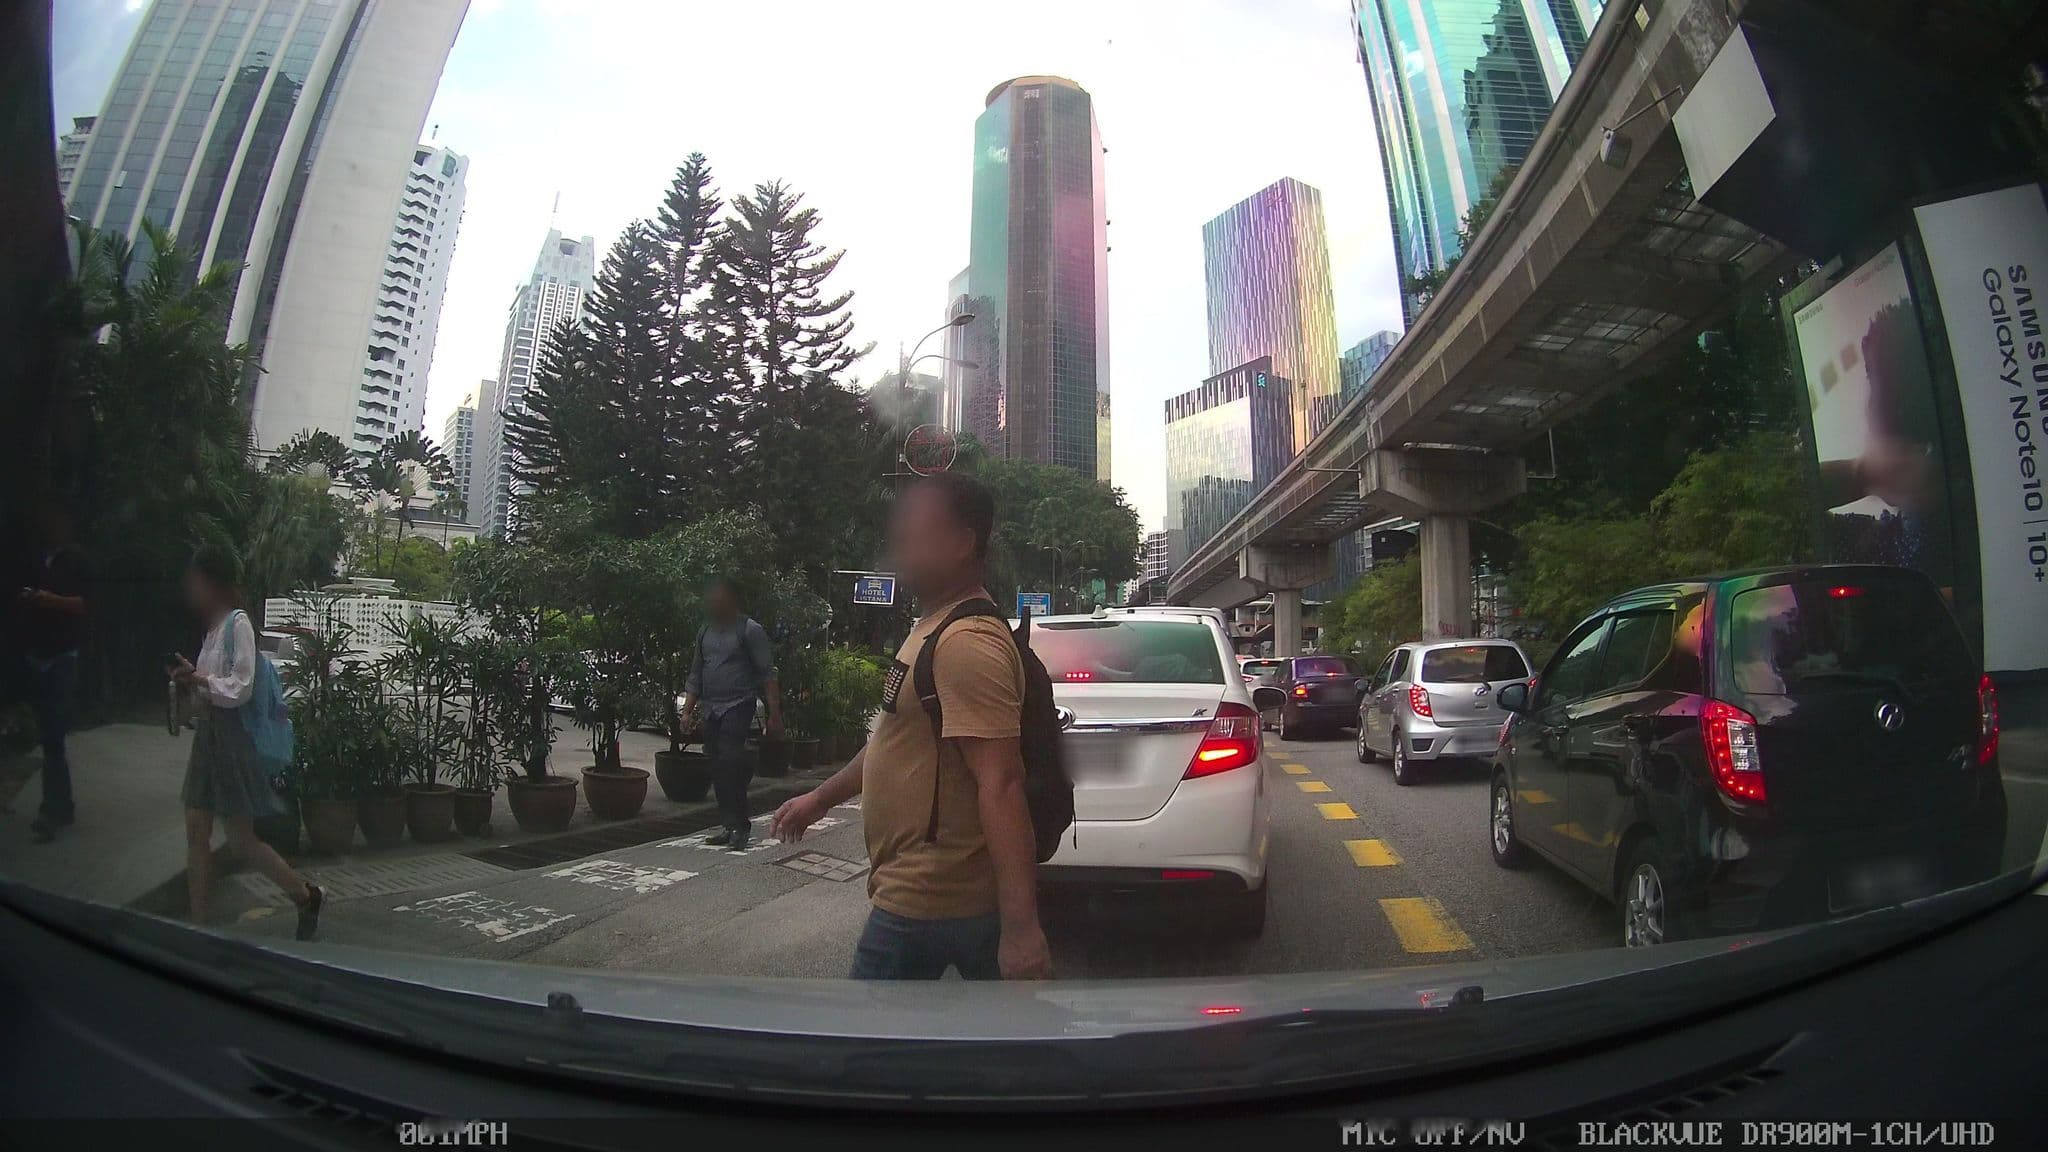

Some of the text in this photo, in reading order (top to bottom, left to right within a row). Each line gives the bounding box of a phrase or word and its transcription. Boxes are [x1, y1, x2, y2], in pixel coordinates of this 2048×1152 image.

[1982, 268, 2048, 582] Galaxy Note10 10+
